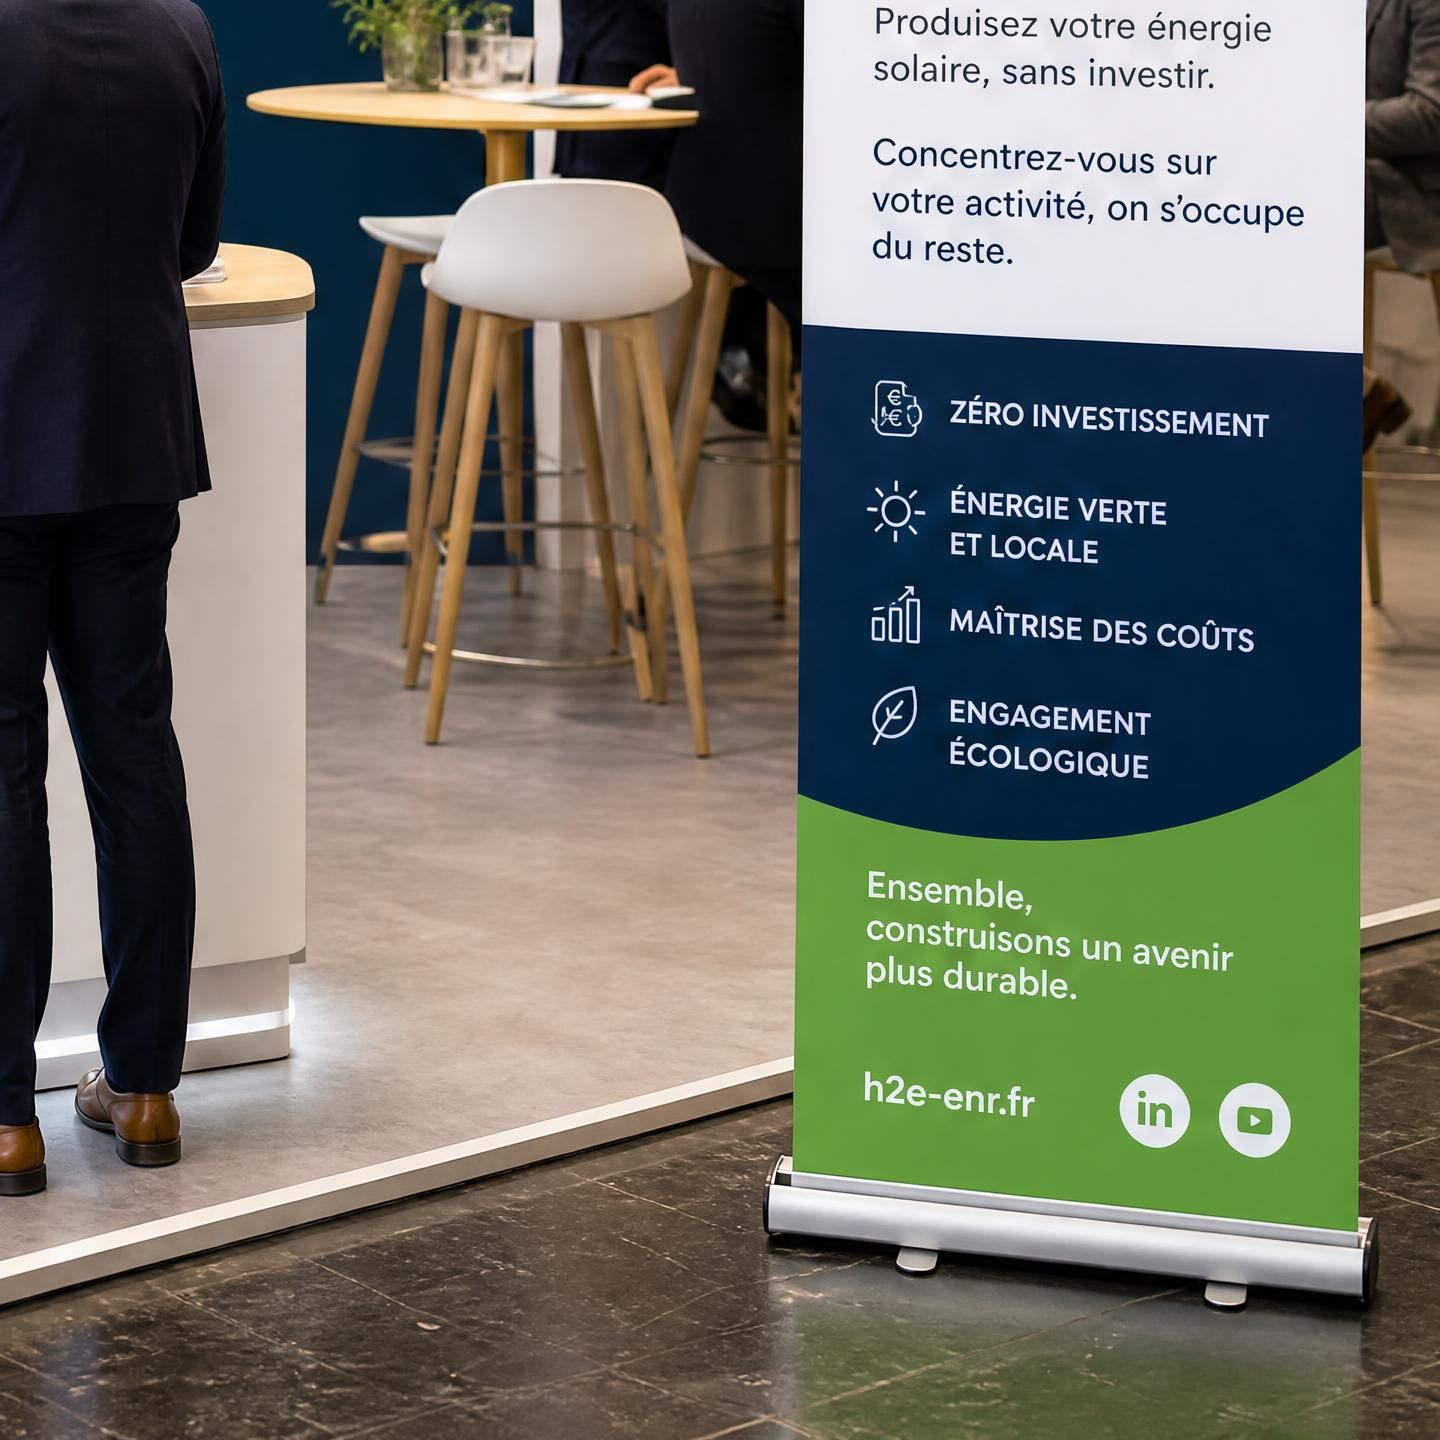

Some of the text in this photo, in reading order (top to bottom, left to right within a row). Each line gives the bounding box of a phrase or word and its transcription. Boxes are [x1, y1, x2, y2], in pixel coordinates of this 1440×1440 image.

[877, 8, 1271, 49] Produisez votre énergie
[875, 54, 1213, 88] solaire, sans investir.
[874, 138, 1217, 175] Concentrez-vous sur
[873, 189, 1304, 233] votre activité, on s’occupe
[873, 231, 1012, 264] du reste.
[950, 395, 1269, 437] ZÉRO INVESTISSEMENT
[951, 485, 1166, 525] ÉNERGIE VERTE
[951, 532, 1098, 563] ET LOCALE
[950, 605, 1254, 652] MAÎTRISE DES COÛTS
[951, 699, 1151, 735] ENGAGEMENT
[950, 736, 1148, 779] ÉCOLOGIQUE
[869, 871, 1032, 915] Ensemble,
[867, 920, 1233, 971] construisons un avenir
[867, 956, 1076, 999] plus durable.
[865, 1071, 1035, 1117] h2e-enr.fr
[1138, 1091, 1172, 1128] in
